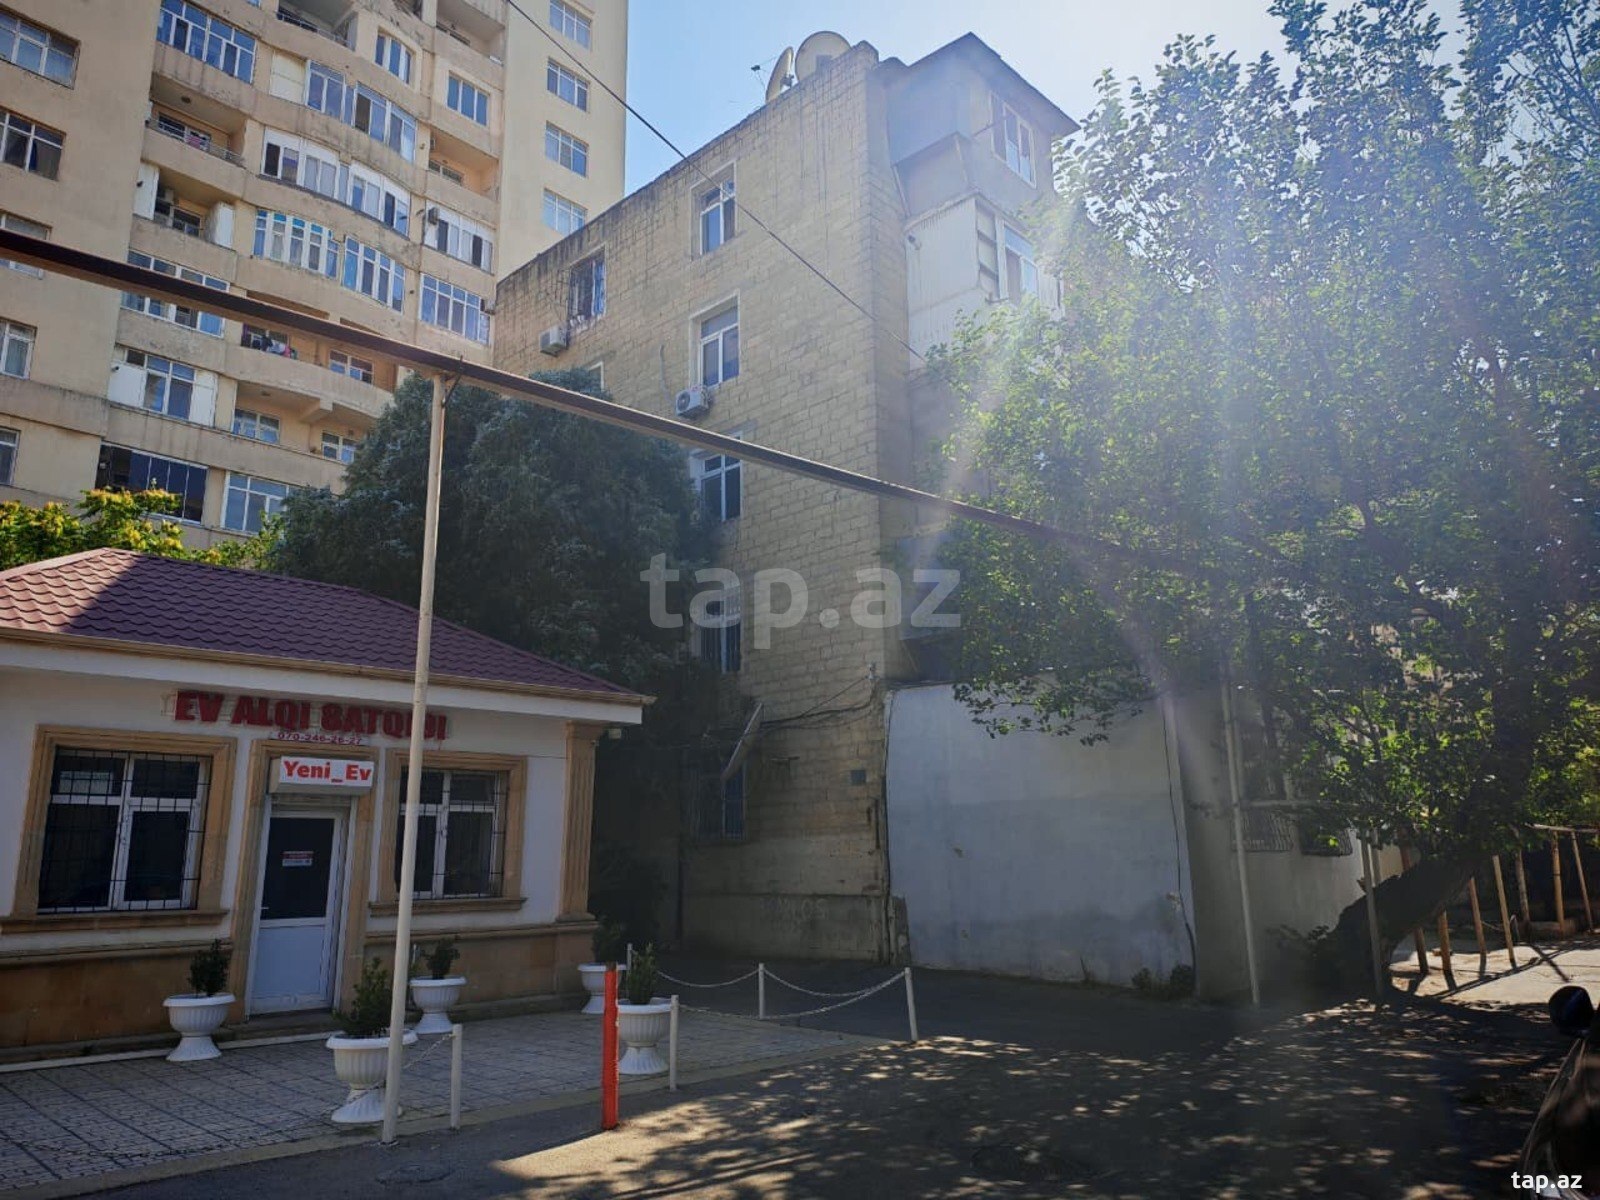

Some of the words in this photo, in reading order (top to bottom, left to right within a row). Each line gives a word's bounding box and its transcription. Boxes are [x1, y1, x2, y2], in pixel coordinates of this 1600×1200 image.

[174, 690, 224, 722] EV
[231, 695, 311, 730] ALQI
[283, 760, 372, 783] Yeni_Ev
